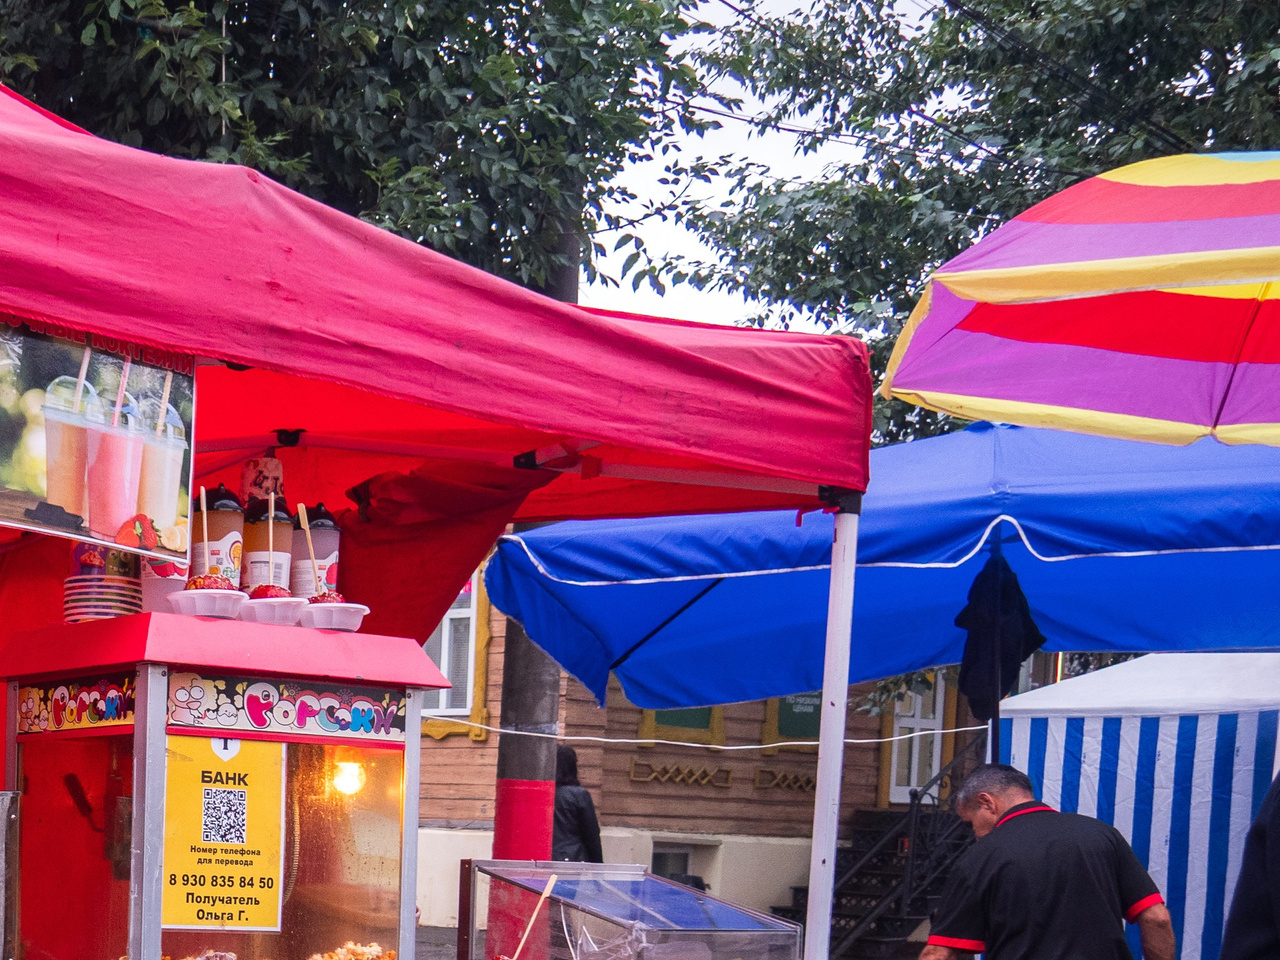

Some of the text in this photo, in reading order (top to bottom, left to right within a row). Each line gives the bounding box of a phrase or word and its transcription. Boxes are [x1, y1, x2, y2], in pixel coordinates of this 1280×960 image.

[243, 682, 396, 735] POPCORN
[201, 770, 249, 786] БАНК
[190, 845, 261, 857] Номер телефона
[197, 858, 254, 867] для перевода
[169, 874, 274, 889] 8 930 835 84 50
[186, 892, 261, 907] Получатель
[196, 909, 249, 921] Ольга Г.
